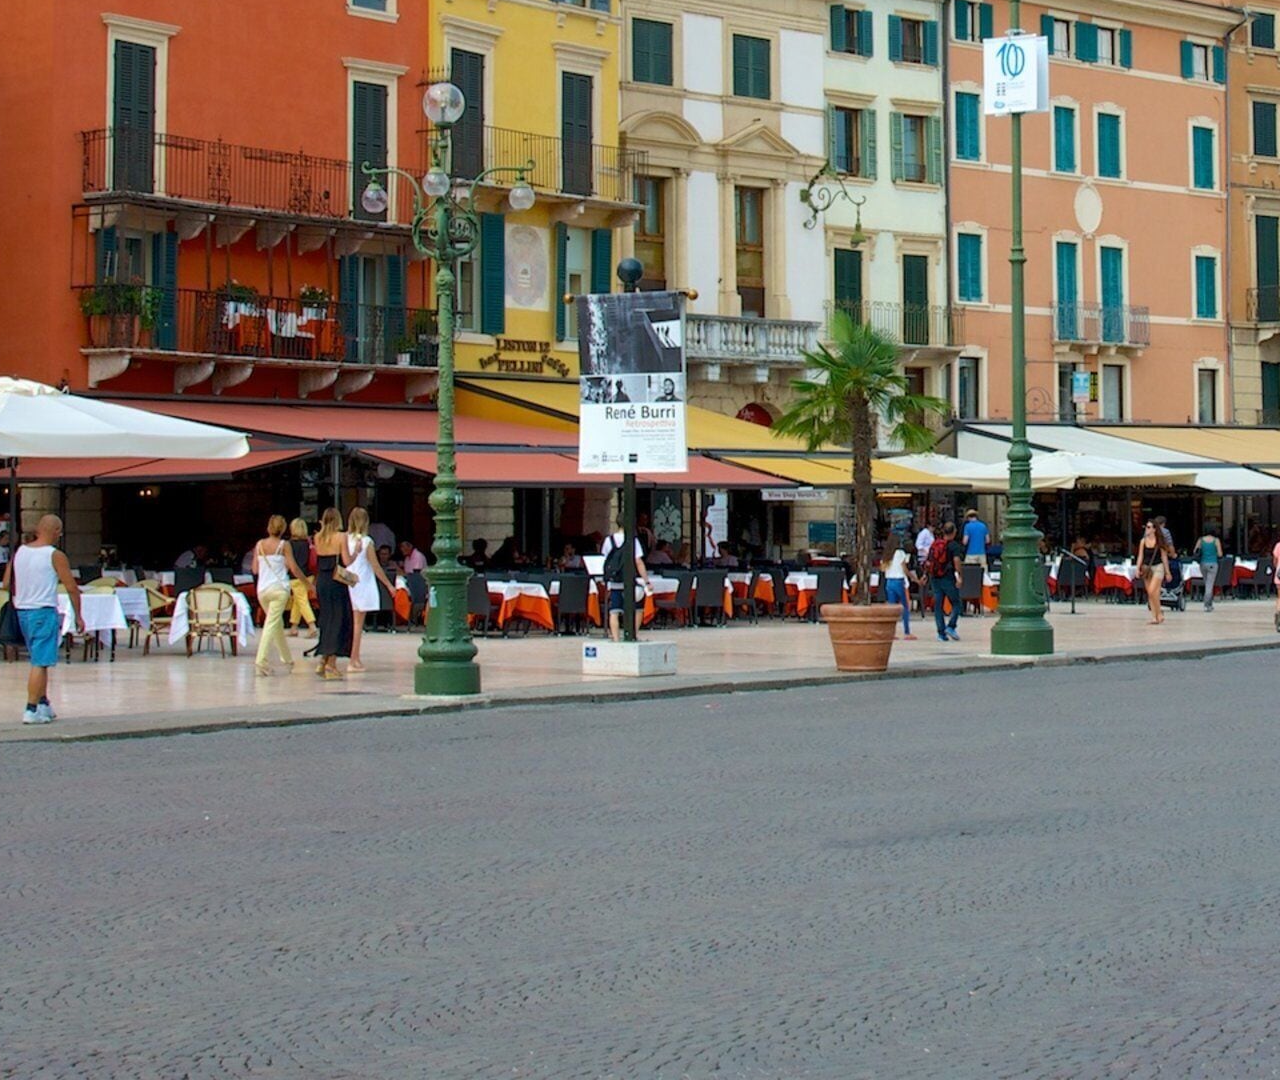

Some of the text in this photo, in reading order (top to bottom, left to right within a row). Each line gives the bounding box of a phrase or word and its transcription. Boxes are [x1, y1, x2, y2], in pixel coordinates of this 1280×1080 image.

[498, 360, 543, 374] PELLINI
[605, 404, 676, 419] René Burri
